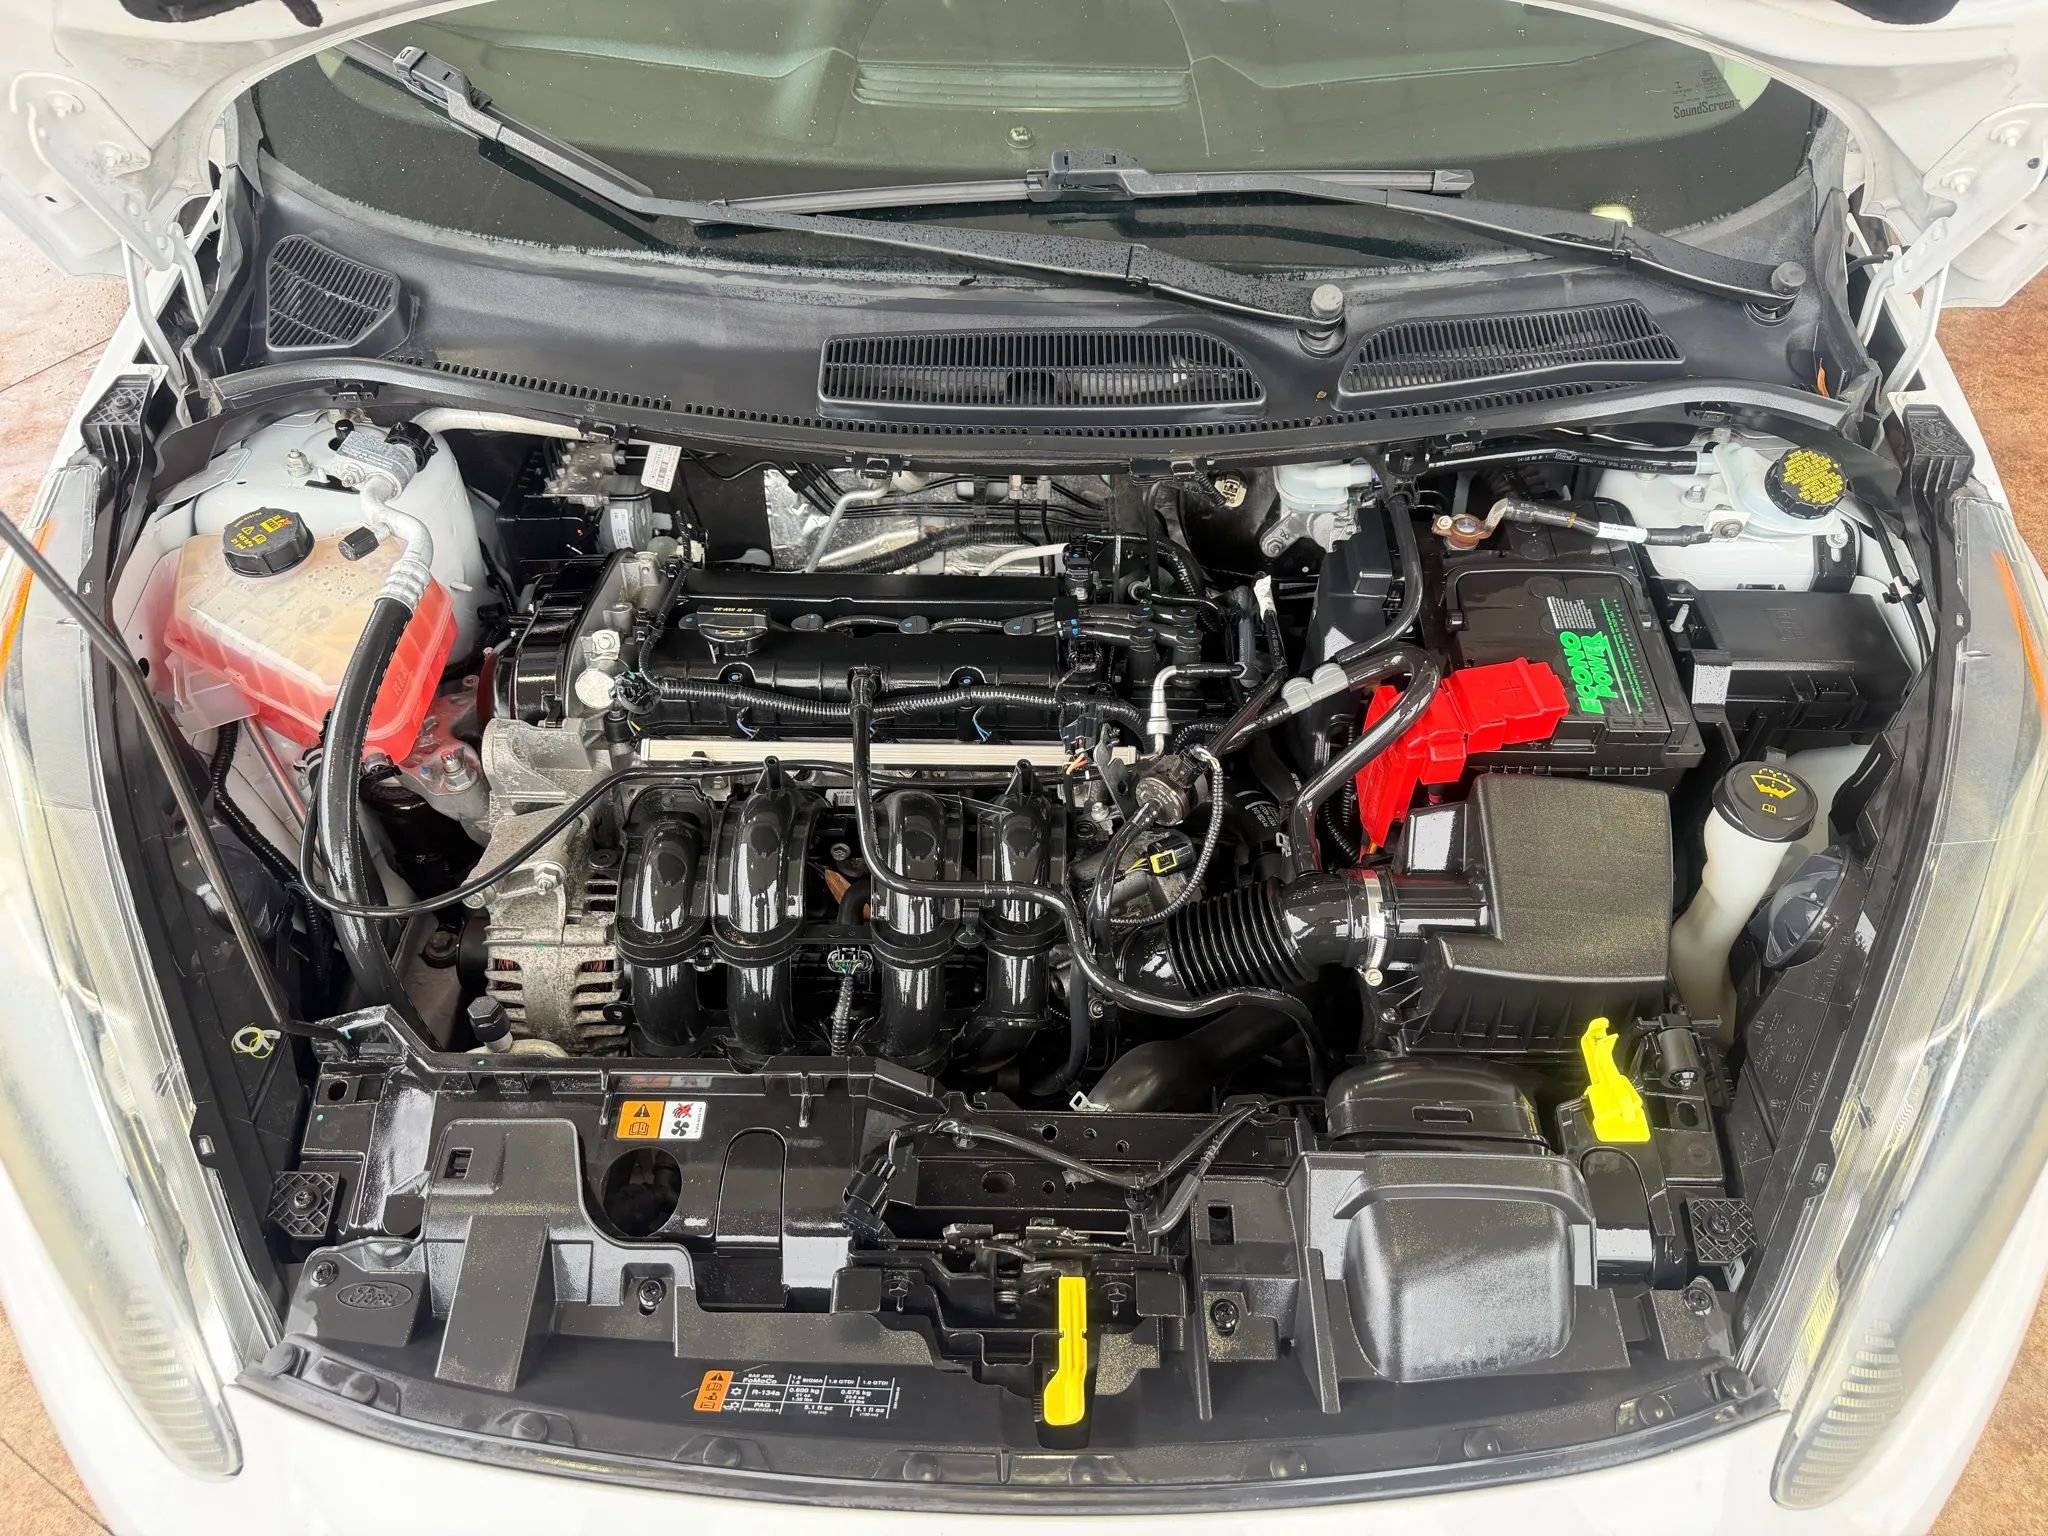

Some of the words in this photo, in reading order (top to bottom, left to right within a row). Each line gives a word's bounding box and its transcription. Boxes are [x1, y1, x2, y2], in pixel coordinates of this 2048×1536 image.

[1673, 100, 1735, 119] SoundScreen
[1560, 631, 1605, 714] ECONO
[1580, 631, 1619, 699] POWER
[347, 1284, 400, 1306] Ford
[751, 1388, 780, 1396] R-134a
